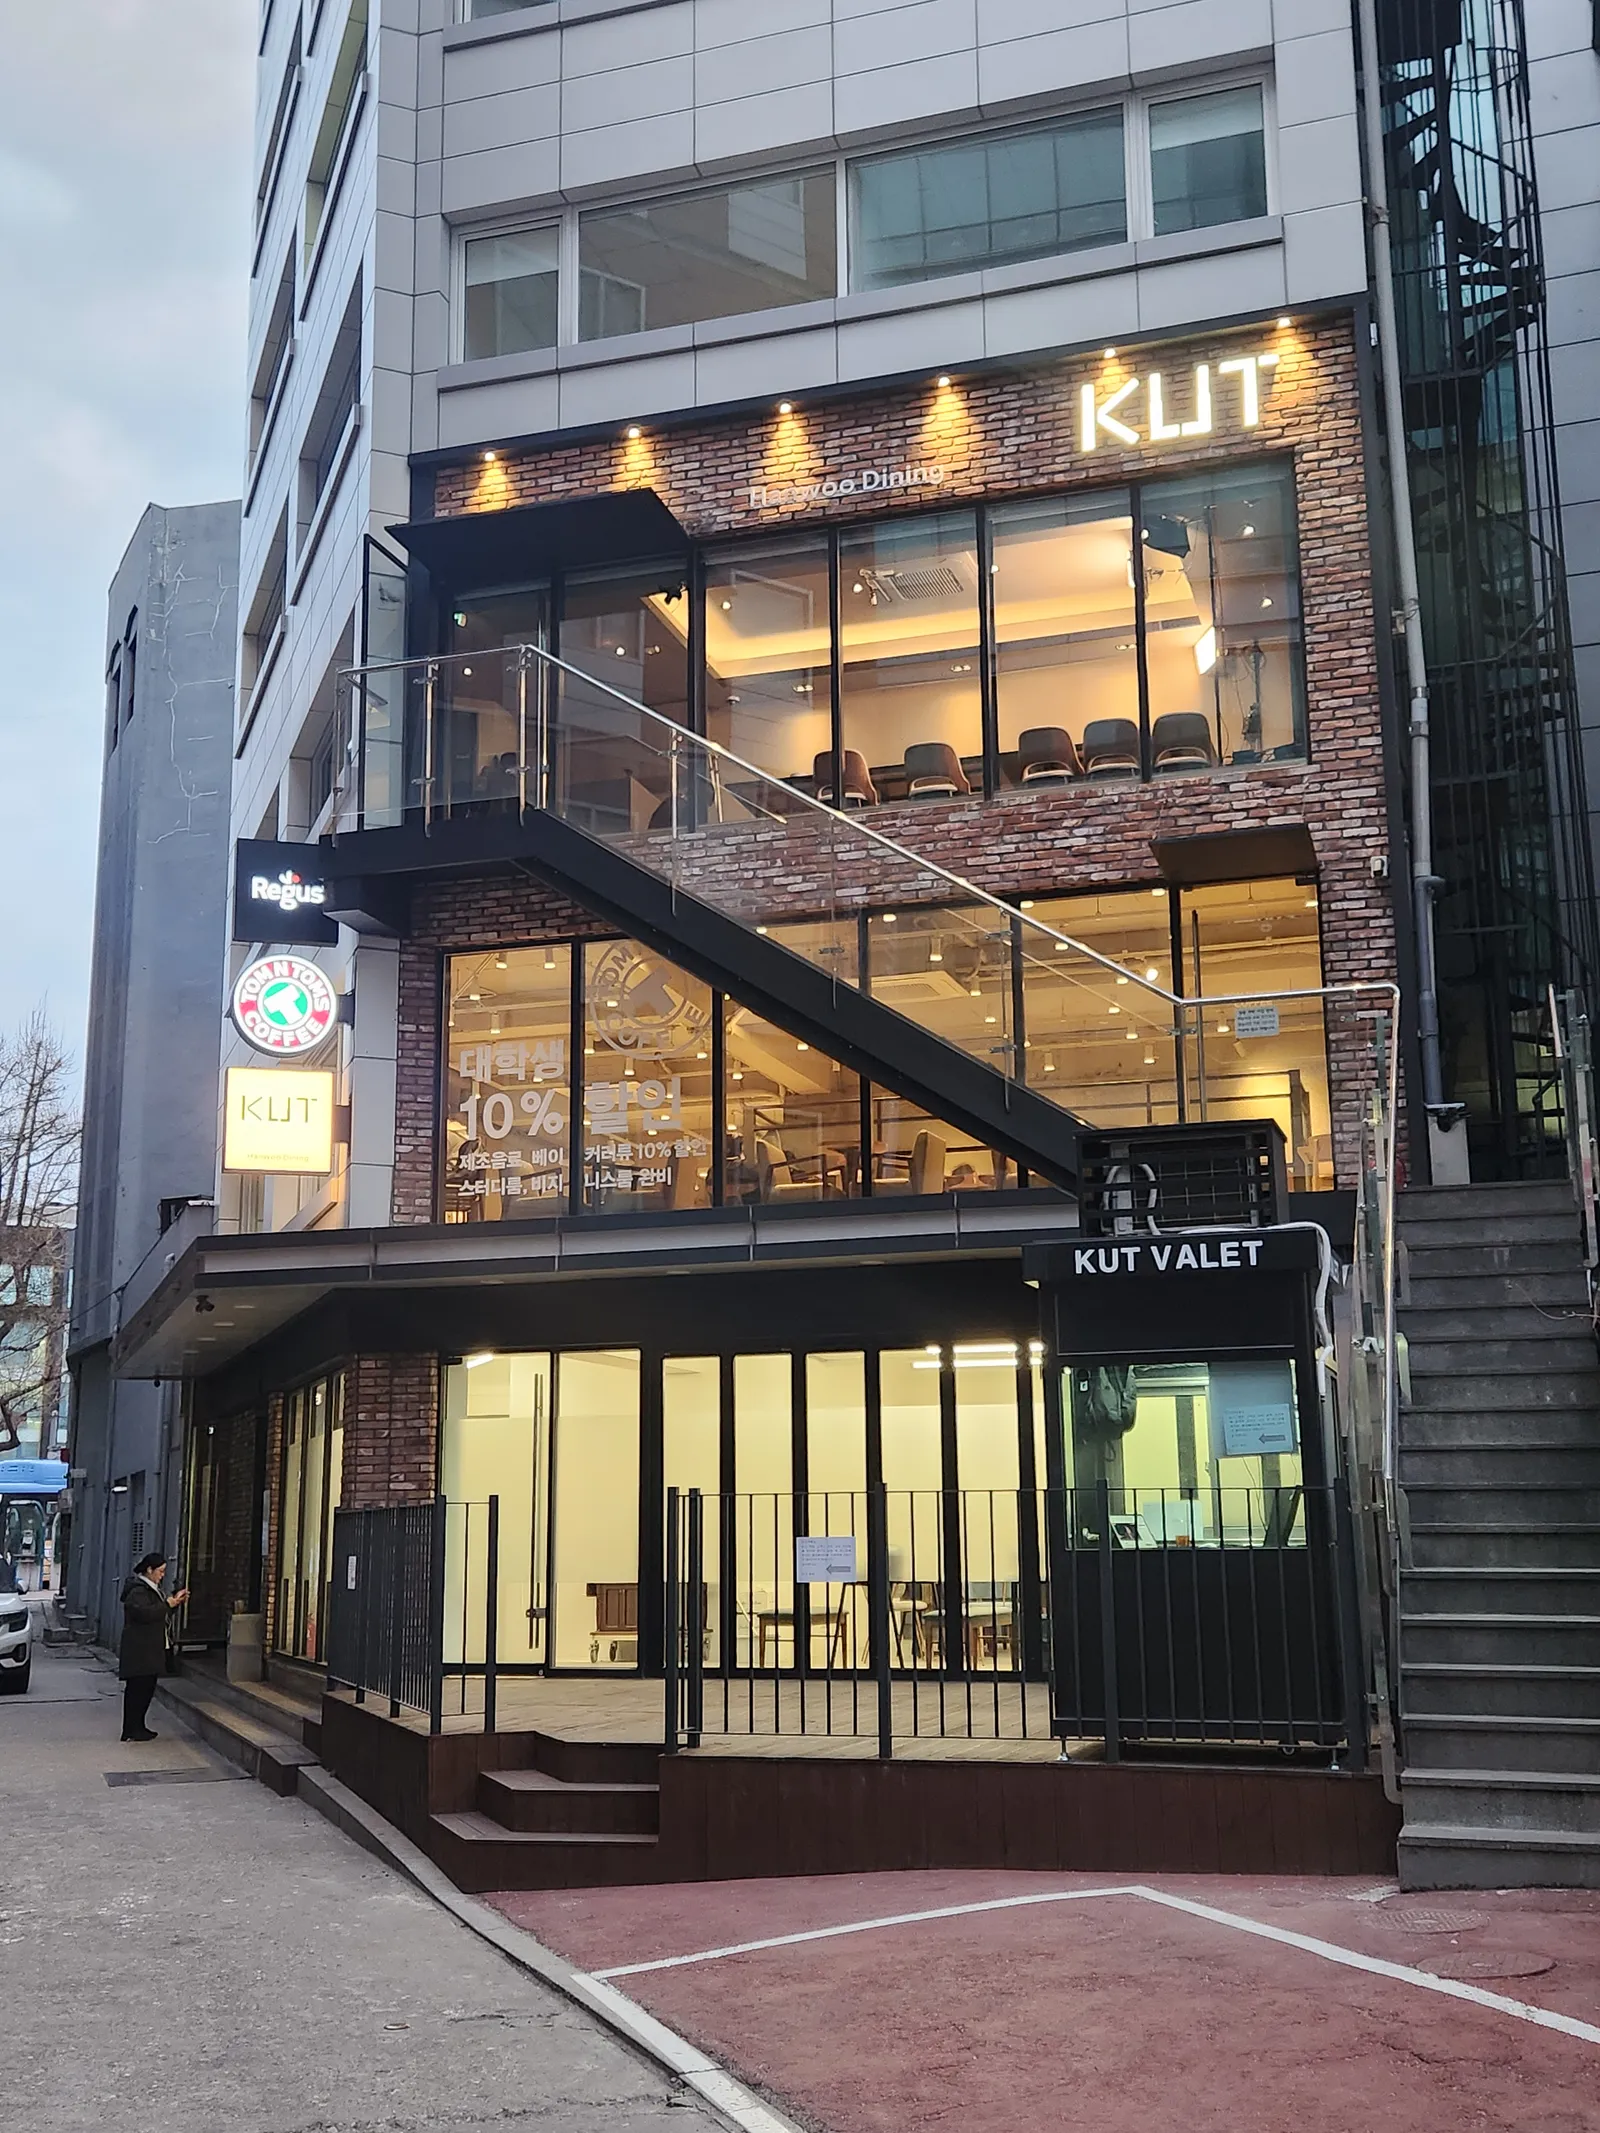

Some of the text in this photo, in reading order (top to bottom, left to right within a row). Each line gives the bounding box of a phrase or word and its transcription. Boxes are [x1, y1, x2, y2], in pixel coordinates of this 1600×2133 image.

[1080, 354, 1280, 452] KUT
[750, 464, 944, 509] Hanwoo Dining
[251, 872, 325, 911] Regus
[241, 960, 330, 1013] TOM N TOMS
[244, 1009, 324, 1048] COFFEE
[459, 1038, 565, 1083] 대학생
[241, 1094, 318, 1124] KUT
[459, 1075, 681, 1141] 10% 할인
[637, 1140, 672, 1160] 10%
[1074, 1240, 1264, 1275] KUT VALET
